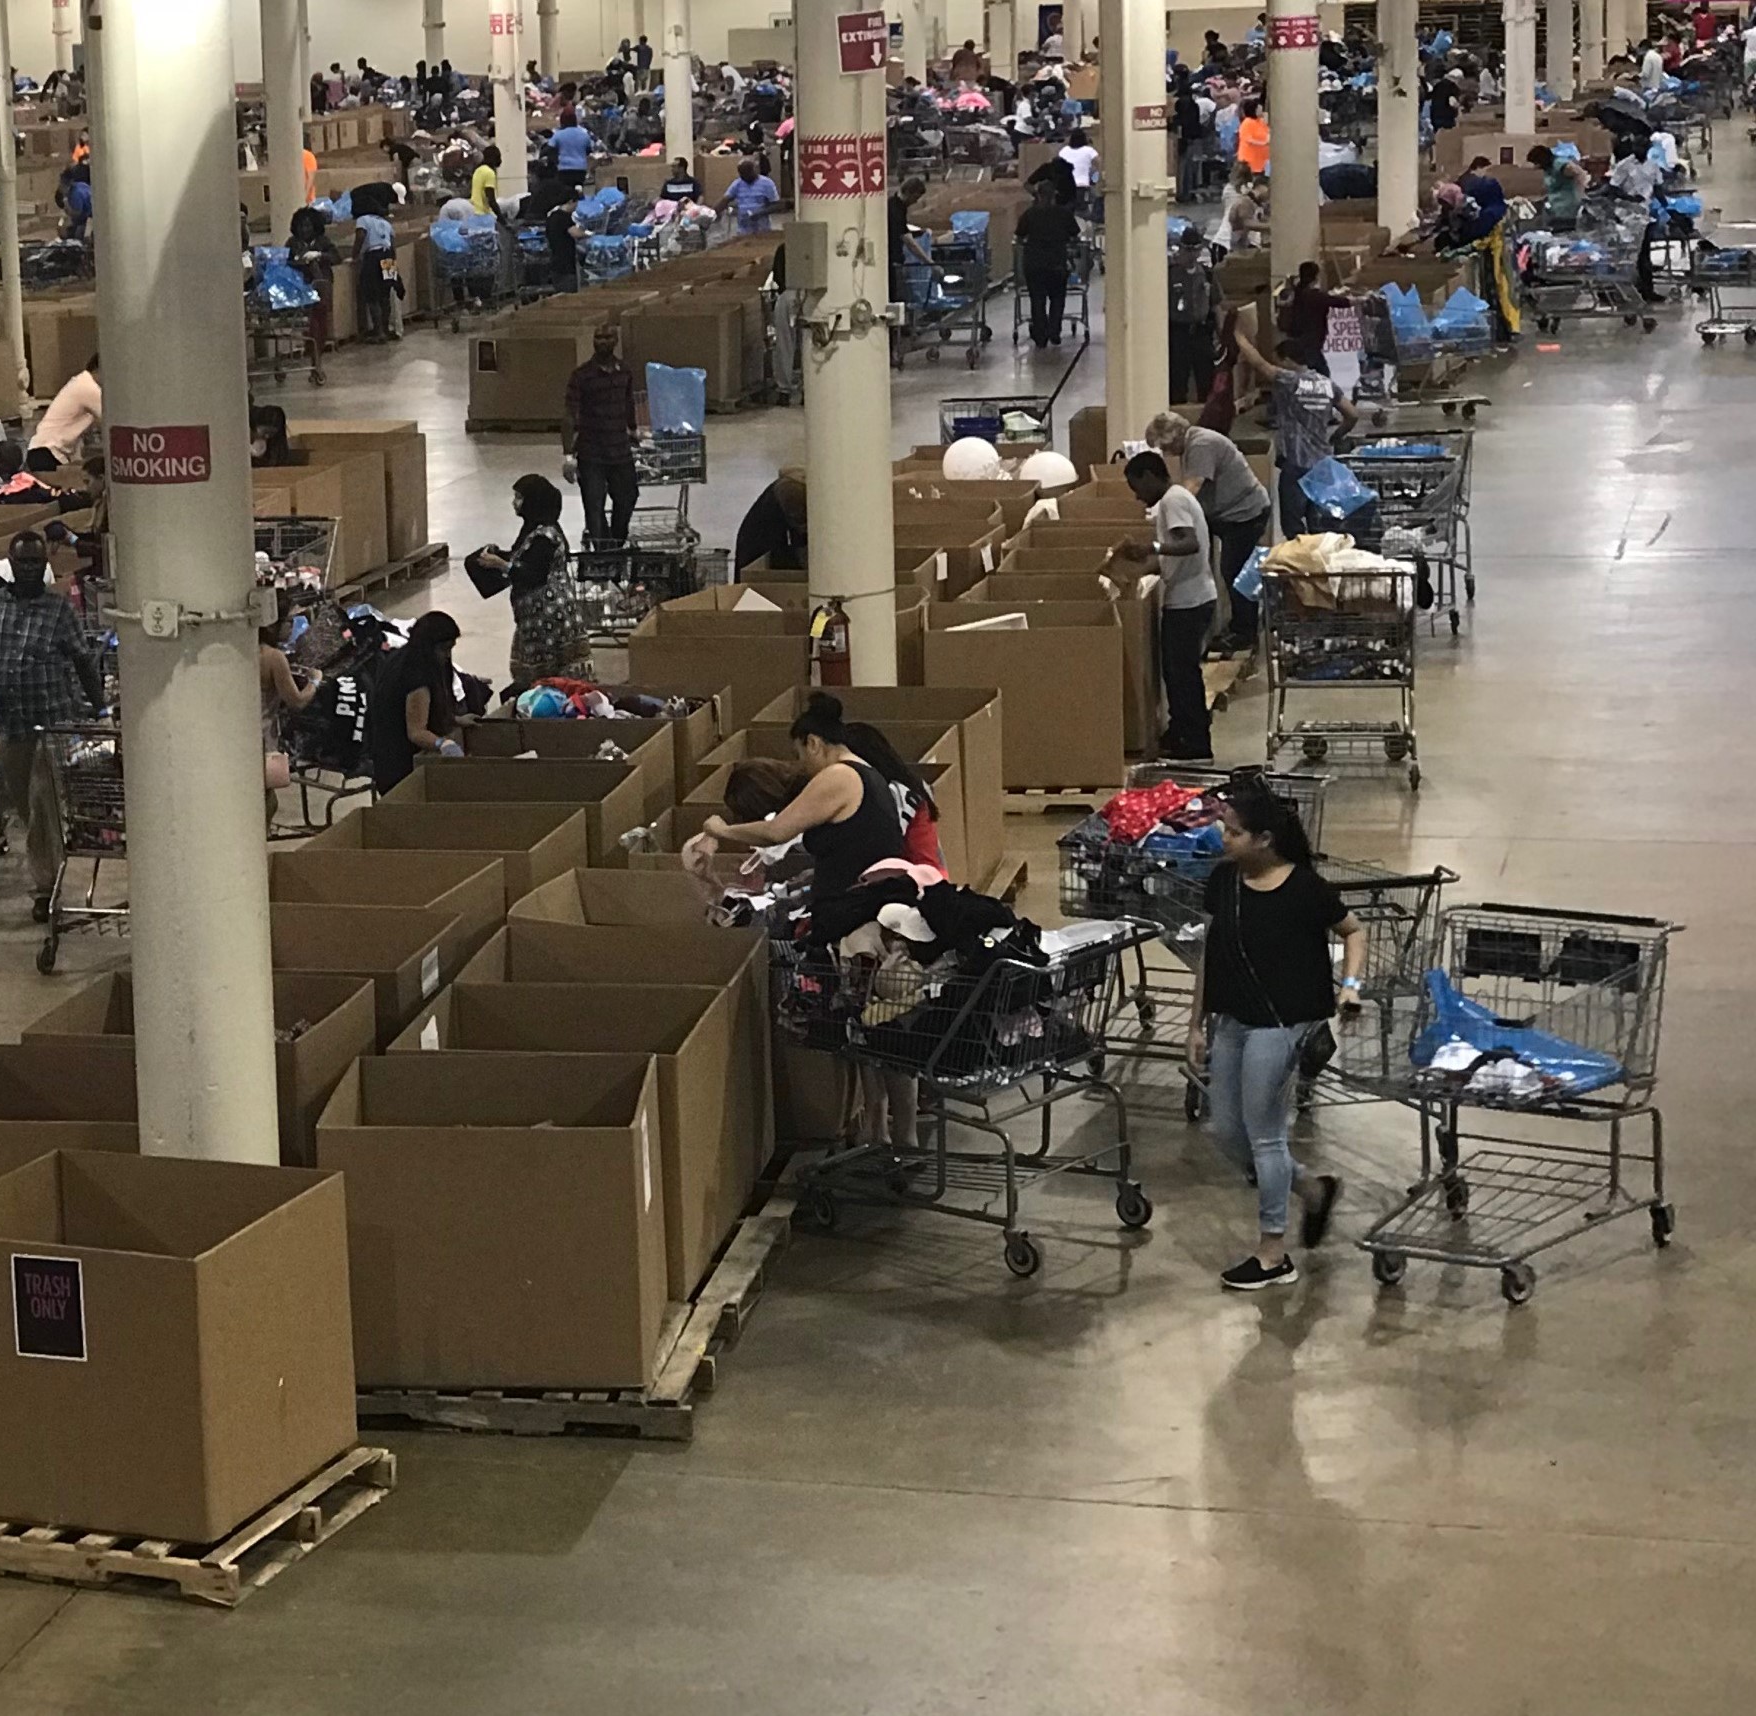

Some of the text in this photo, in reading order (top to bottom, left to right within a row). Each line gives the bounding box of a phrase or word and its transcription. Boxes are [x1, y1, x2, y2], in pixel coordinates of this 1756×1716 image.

[807, 144, 830, 155] FIRE
[132, 432, 166, 453] NO
[111, 455, 206, 478] SMOKING
[23, 1271, 71, 1298] TRASH
[30, 1296, 68, 1321] ONLY
